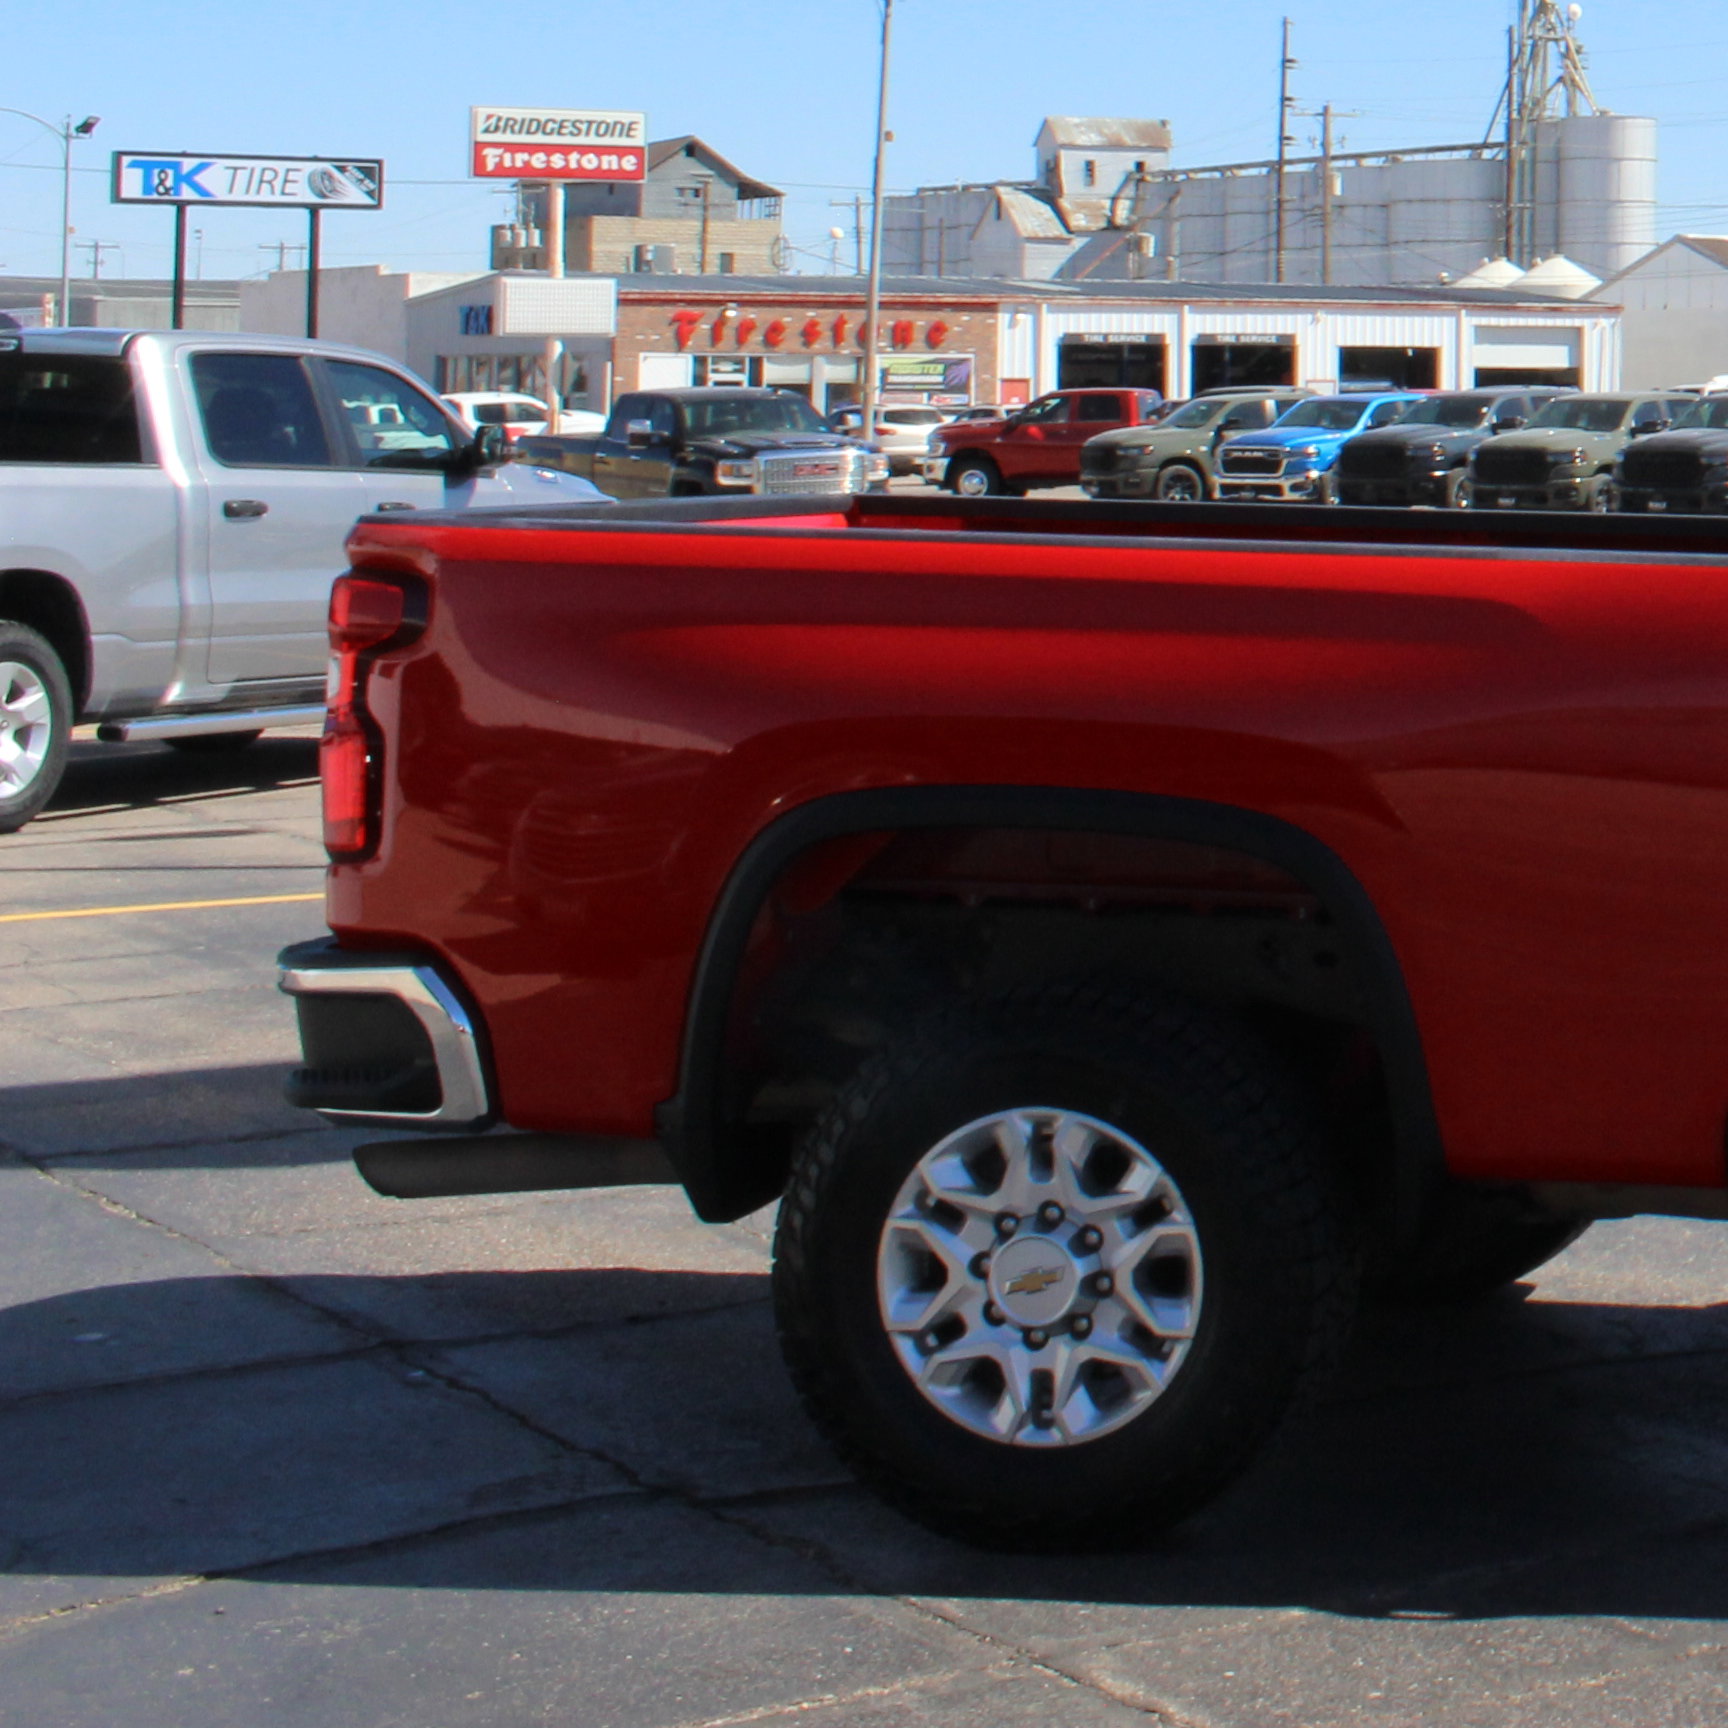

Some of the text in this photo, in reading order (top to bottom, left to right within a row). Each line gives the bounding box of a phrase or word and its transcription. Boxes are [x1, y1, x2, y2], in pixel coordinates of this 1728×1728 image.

[481, 114, 640, 138] BRIDGESTONE
[482, 147, 639, 172] Firestone
[125, 159, 217, 198] T&K
[224, 165, 302, 197] TIRE
[1083, 334, 1147, 343] TIRE SERVICE
[1216, 335, 1277, 344] TIRE SERVICE
